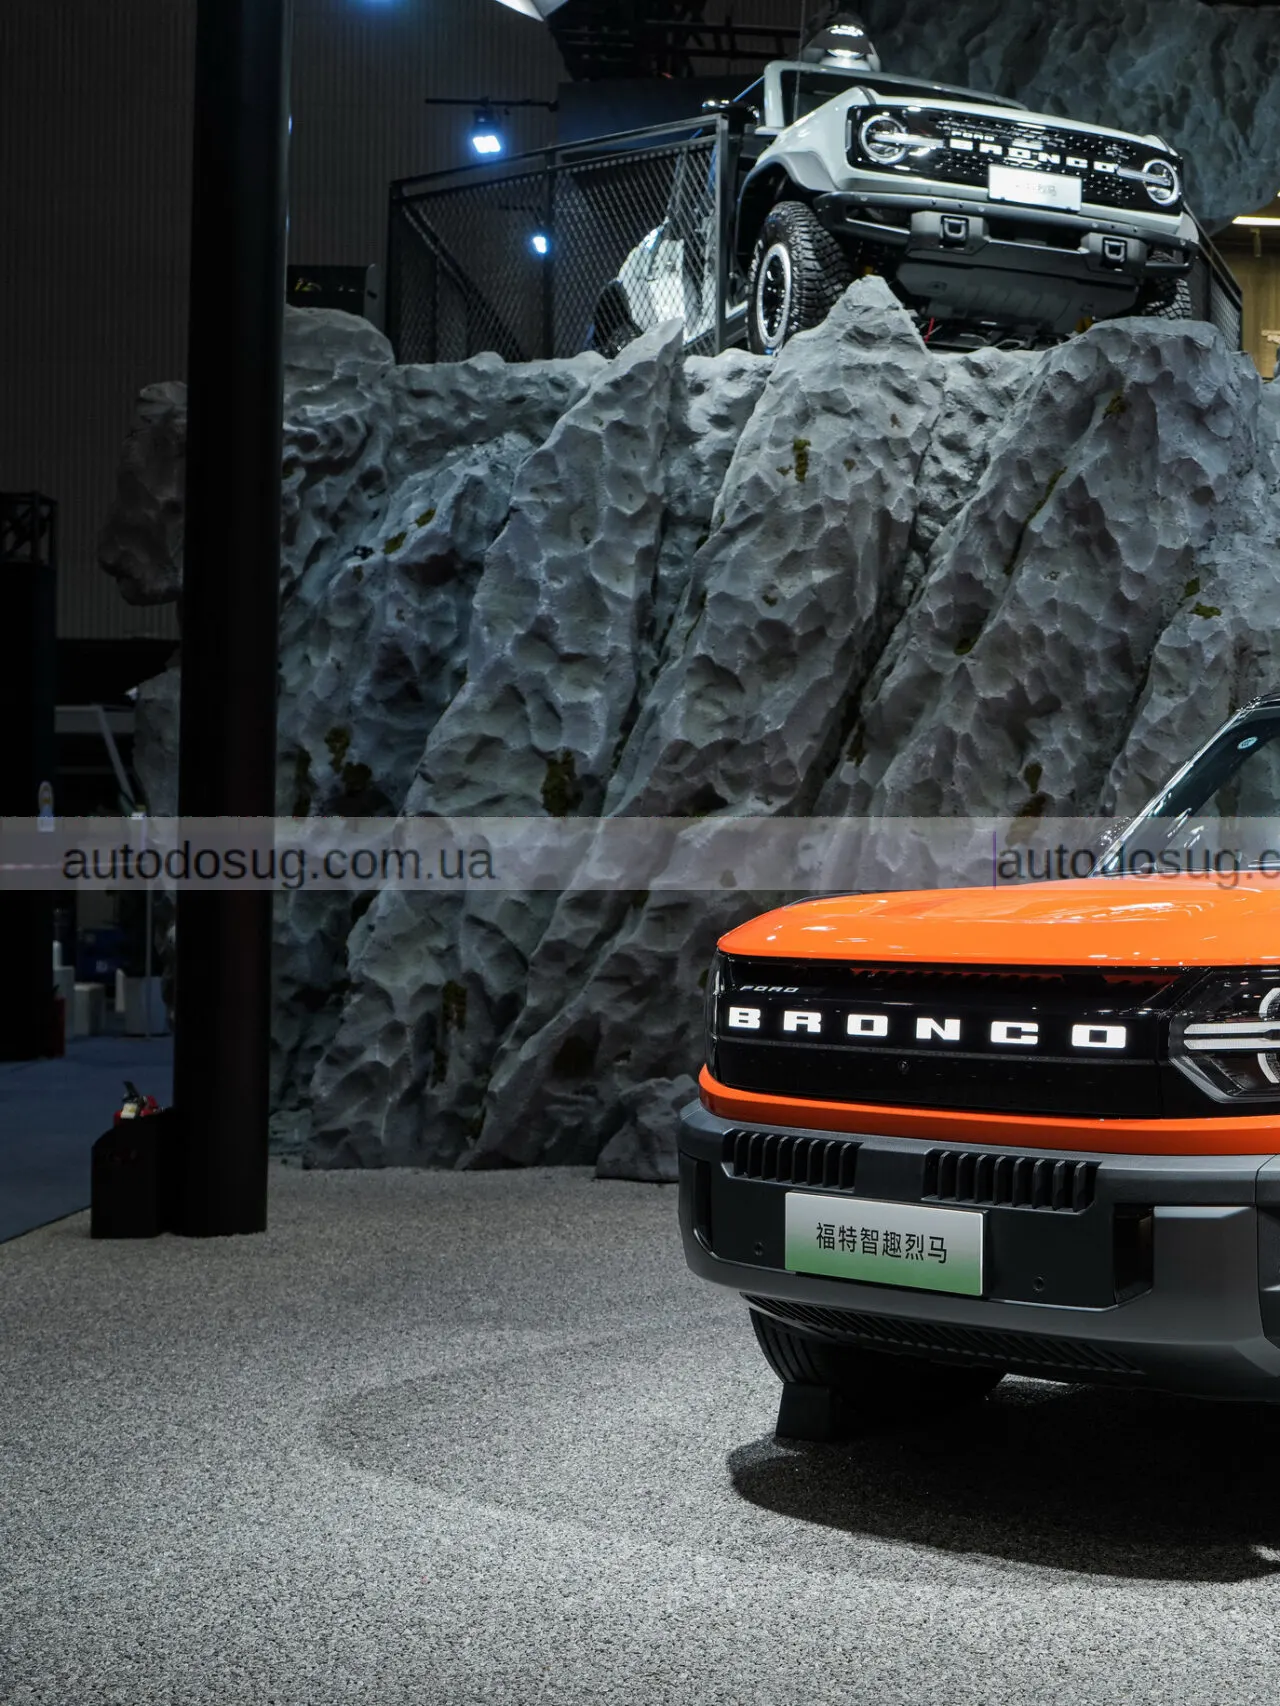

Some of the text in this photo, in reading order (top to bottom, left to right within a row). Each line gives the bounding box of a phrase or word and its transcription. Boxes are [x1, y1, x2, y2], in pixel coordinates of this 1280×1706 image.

[949, 138, 1117, 174] BRONCO
[739, 984, 799, 994] FORD
[728, 1006, 1127, 1049] BRONCO
[815, 1222, 948, 1264] 福特智趣烈马
